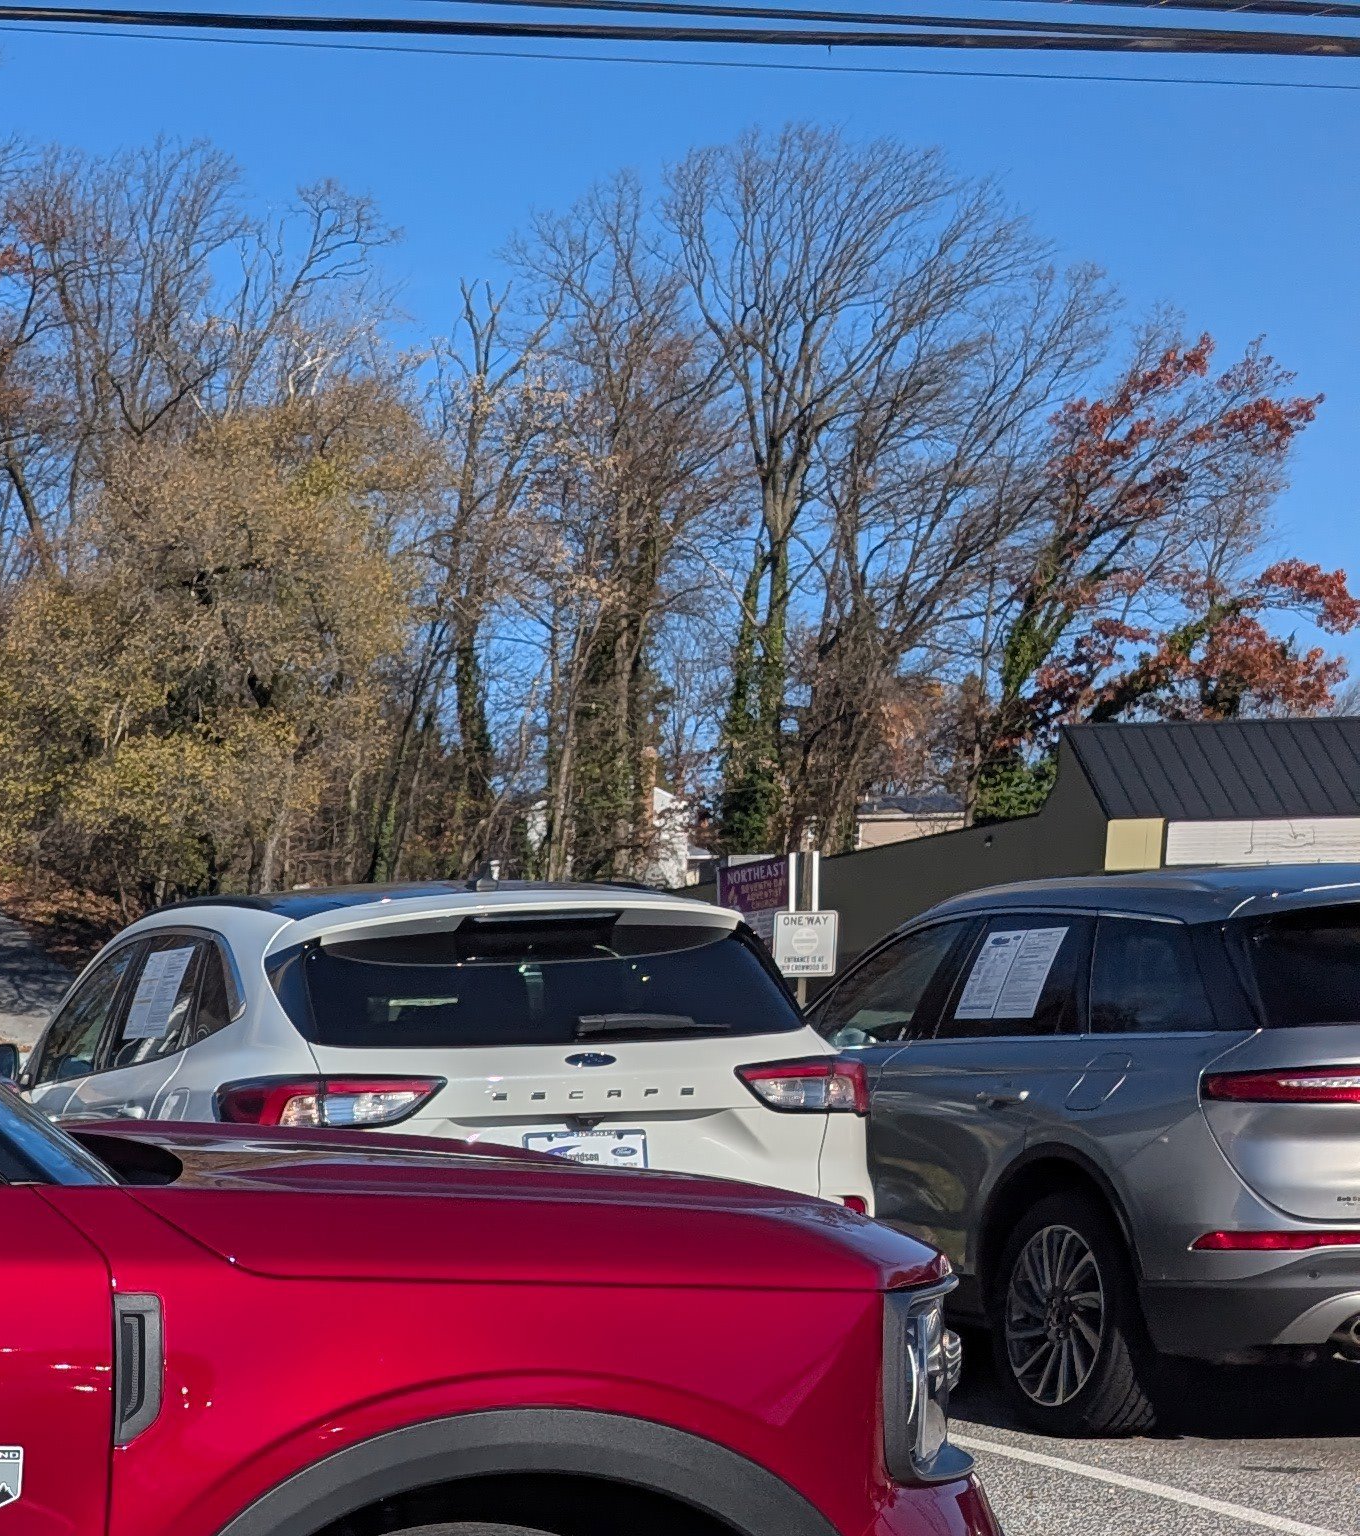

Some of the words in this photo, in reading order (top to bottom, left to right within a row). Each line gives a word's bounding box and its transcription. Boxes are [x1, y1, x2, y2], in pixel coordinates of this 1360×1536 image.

[727, 861, 786, 885] NORTHEAST
[783, 916, 803, 926] ONE
[806, 916, 829, 926] WAY
[492, 1087, 694, 1101] ESCAPE
